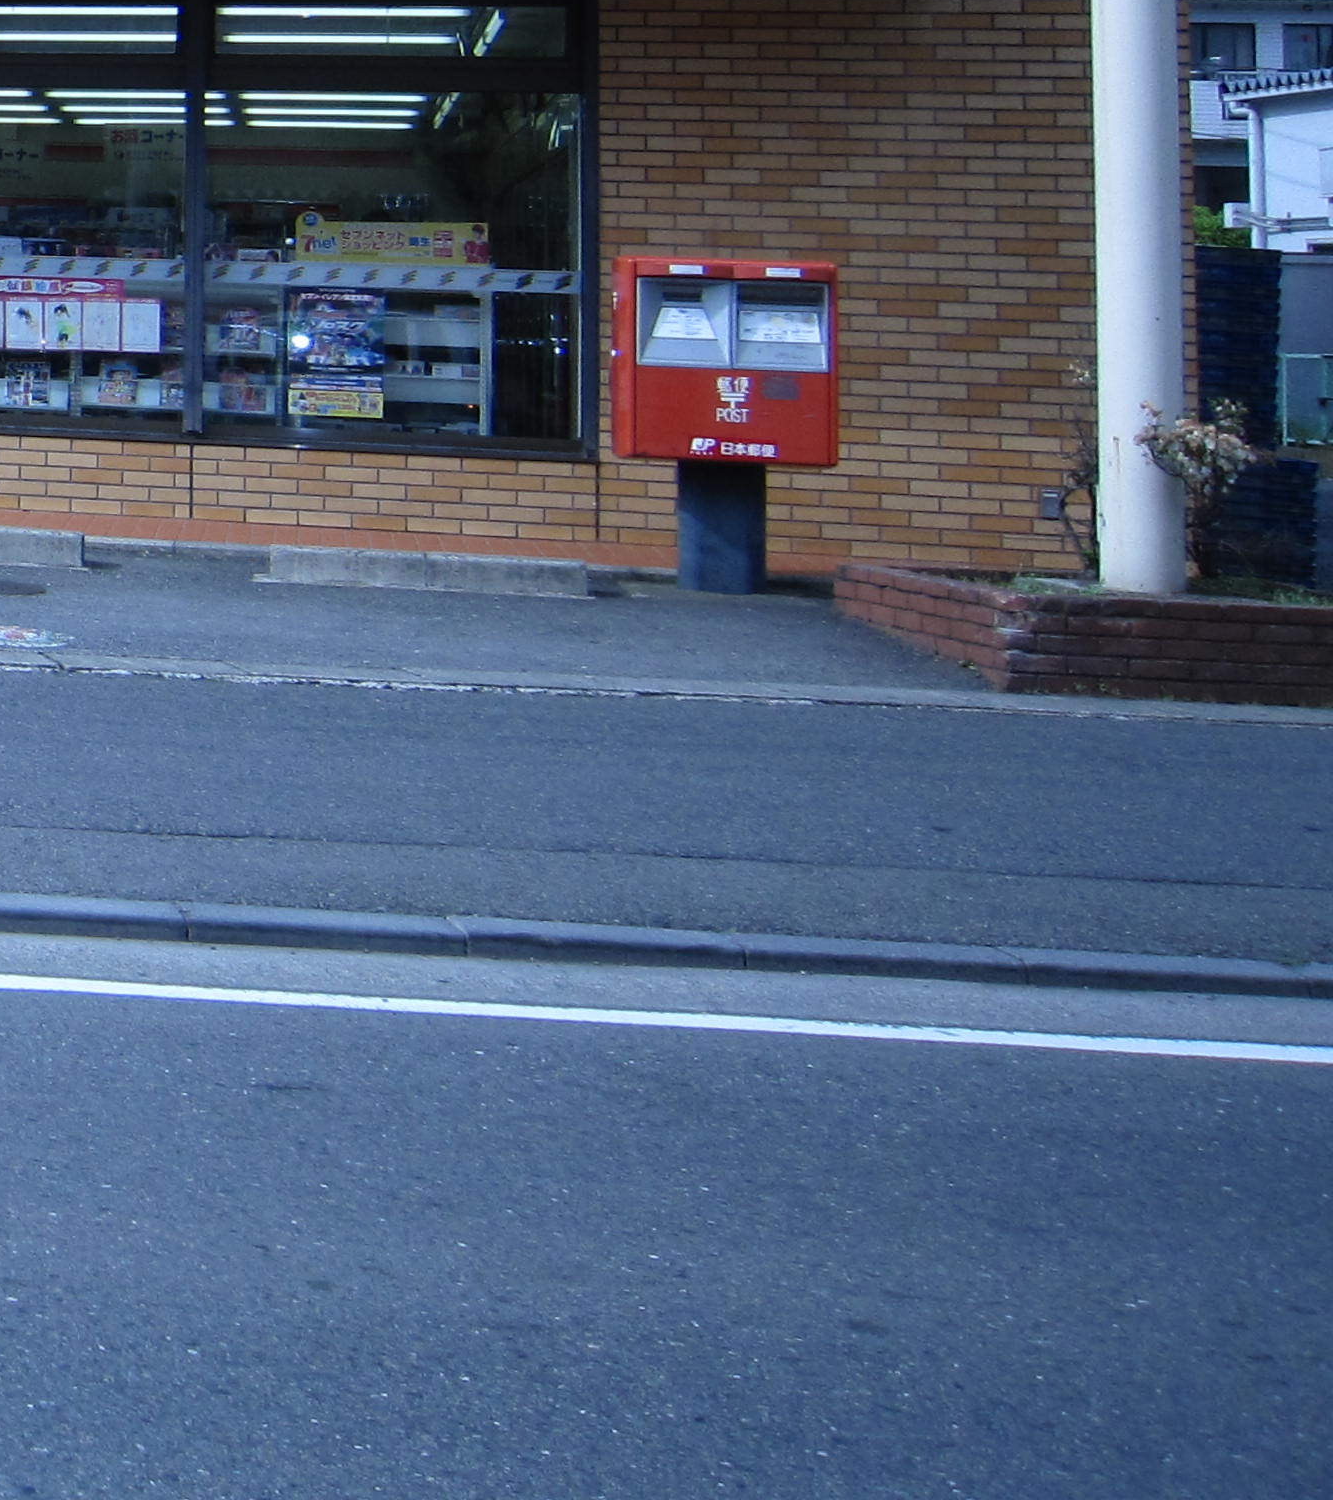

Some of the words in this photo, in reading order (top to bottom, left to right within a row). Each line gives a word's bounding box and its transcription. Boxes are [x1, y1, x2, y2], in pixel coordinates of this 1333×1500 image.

[716, 375, 750, 394] 郵便
[716, 407, 750, 423] POST
[720, 441, 777, 458] 日本郵便
